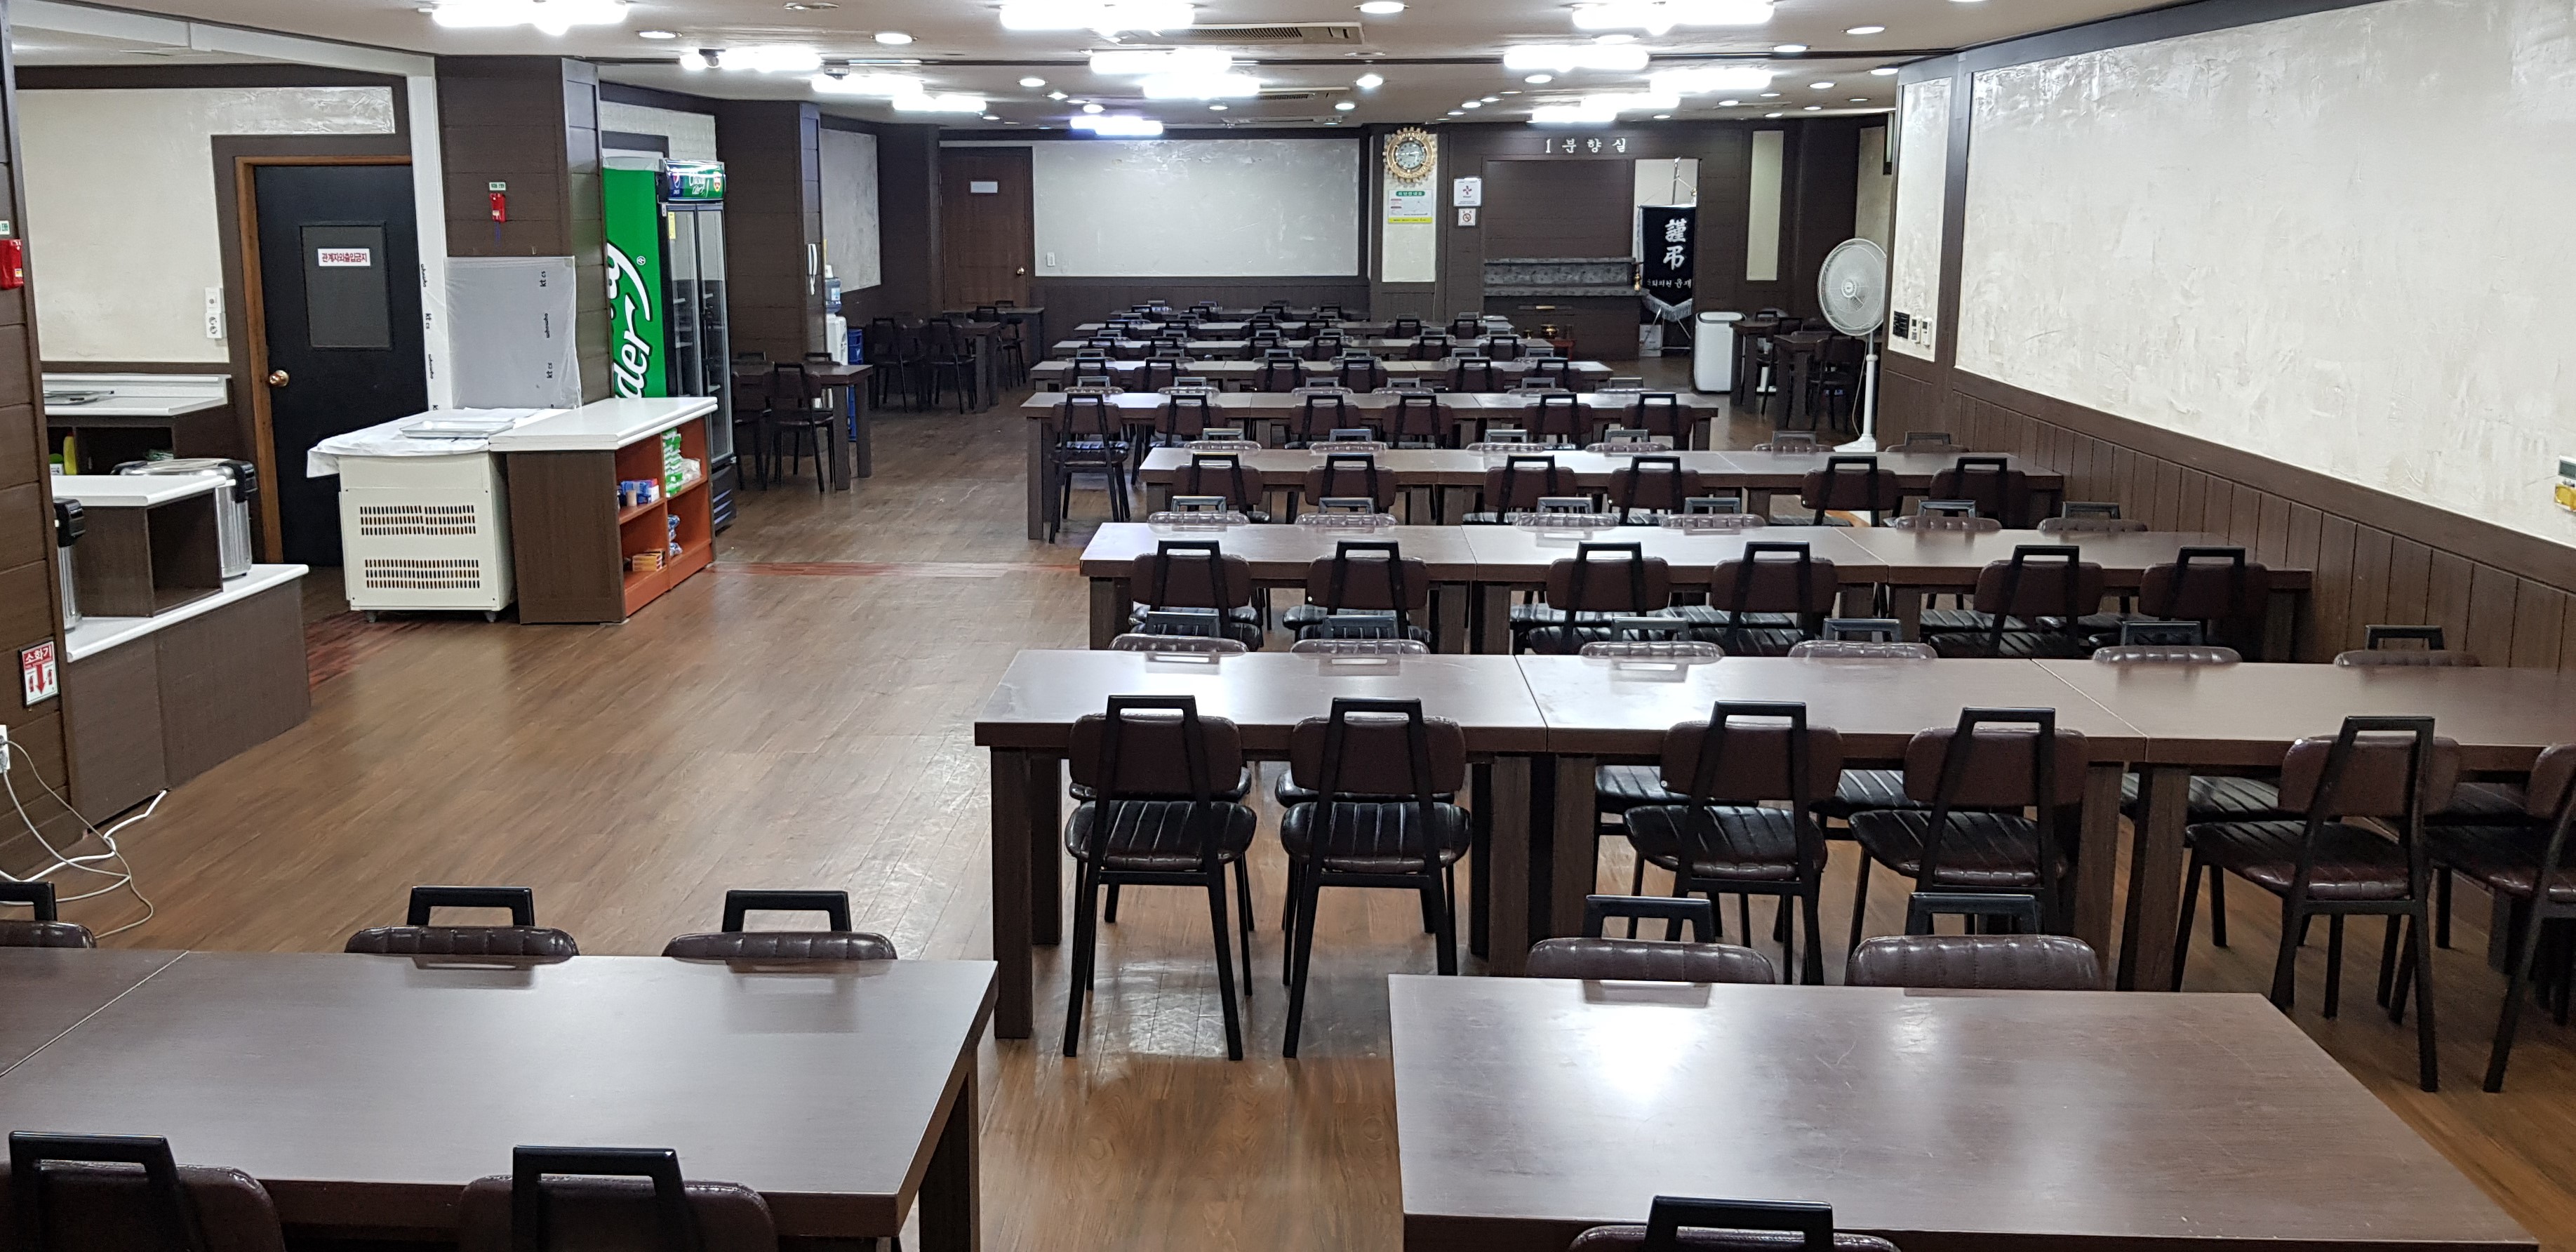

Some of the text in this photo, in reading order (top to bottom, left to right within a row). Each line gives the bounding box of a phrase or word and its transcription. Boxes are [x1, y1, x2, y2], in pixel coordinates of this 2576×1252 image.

[321, 253, 367, 262] 관계자외출입금지
[613, 294, 650, 398] der
[25, 645, 52, 664] 소화기
